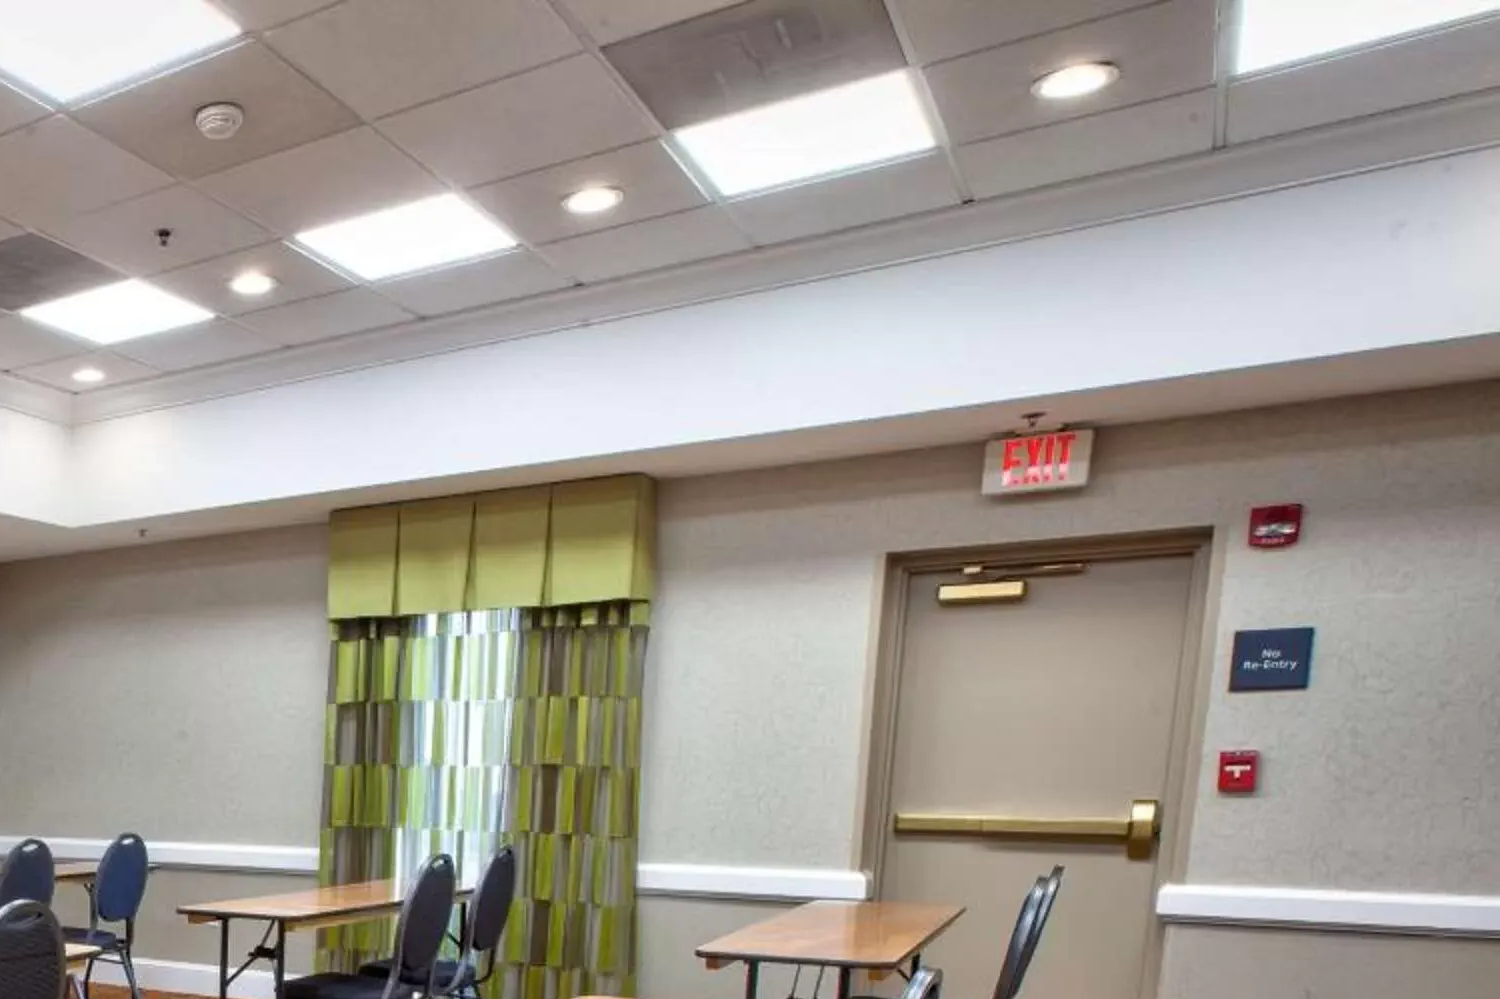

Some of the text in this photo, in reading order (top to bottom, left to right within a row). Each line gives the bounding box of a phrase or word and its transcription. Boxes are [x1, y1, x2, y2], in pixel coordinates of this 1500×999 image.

[1002, 433, 1076, 487] EXIT
[1261, 648, 1281, 659] No
[1243, 660, 1298, 671] Re-Entry
